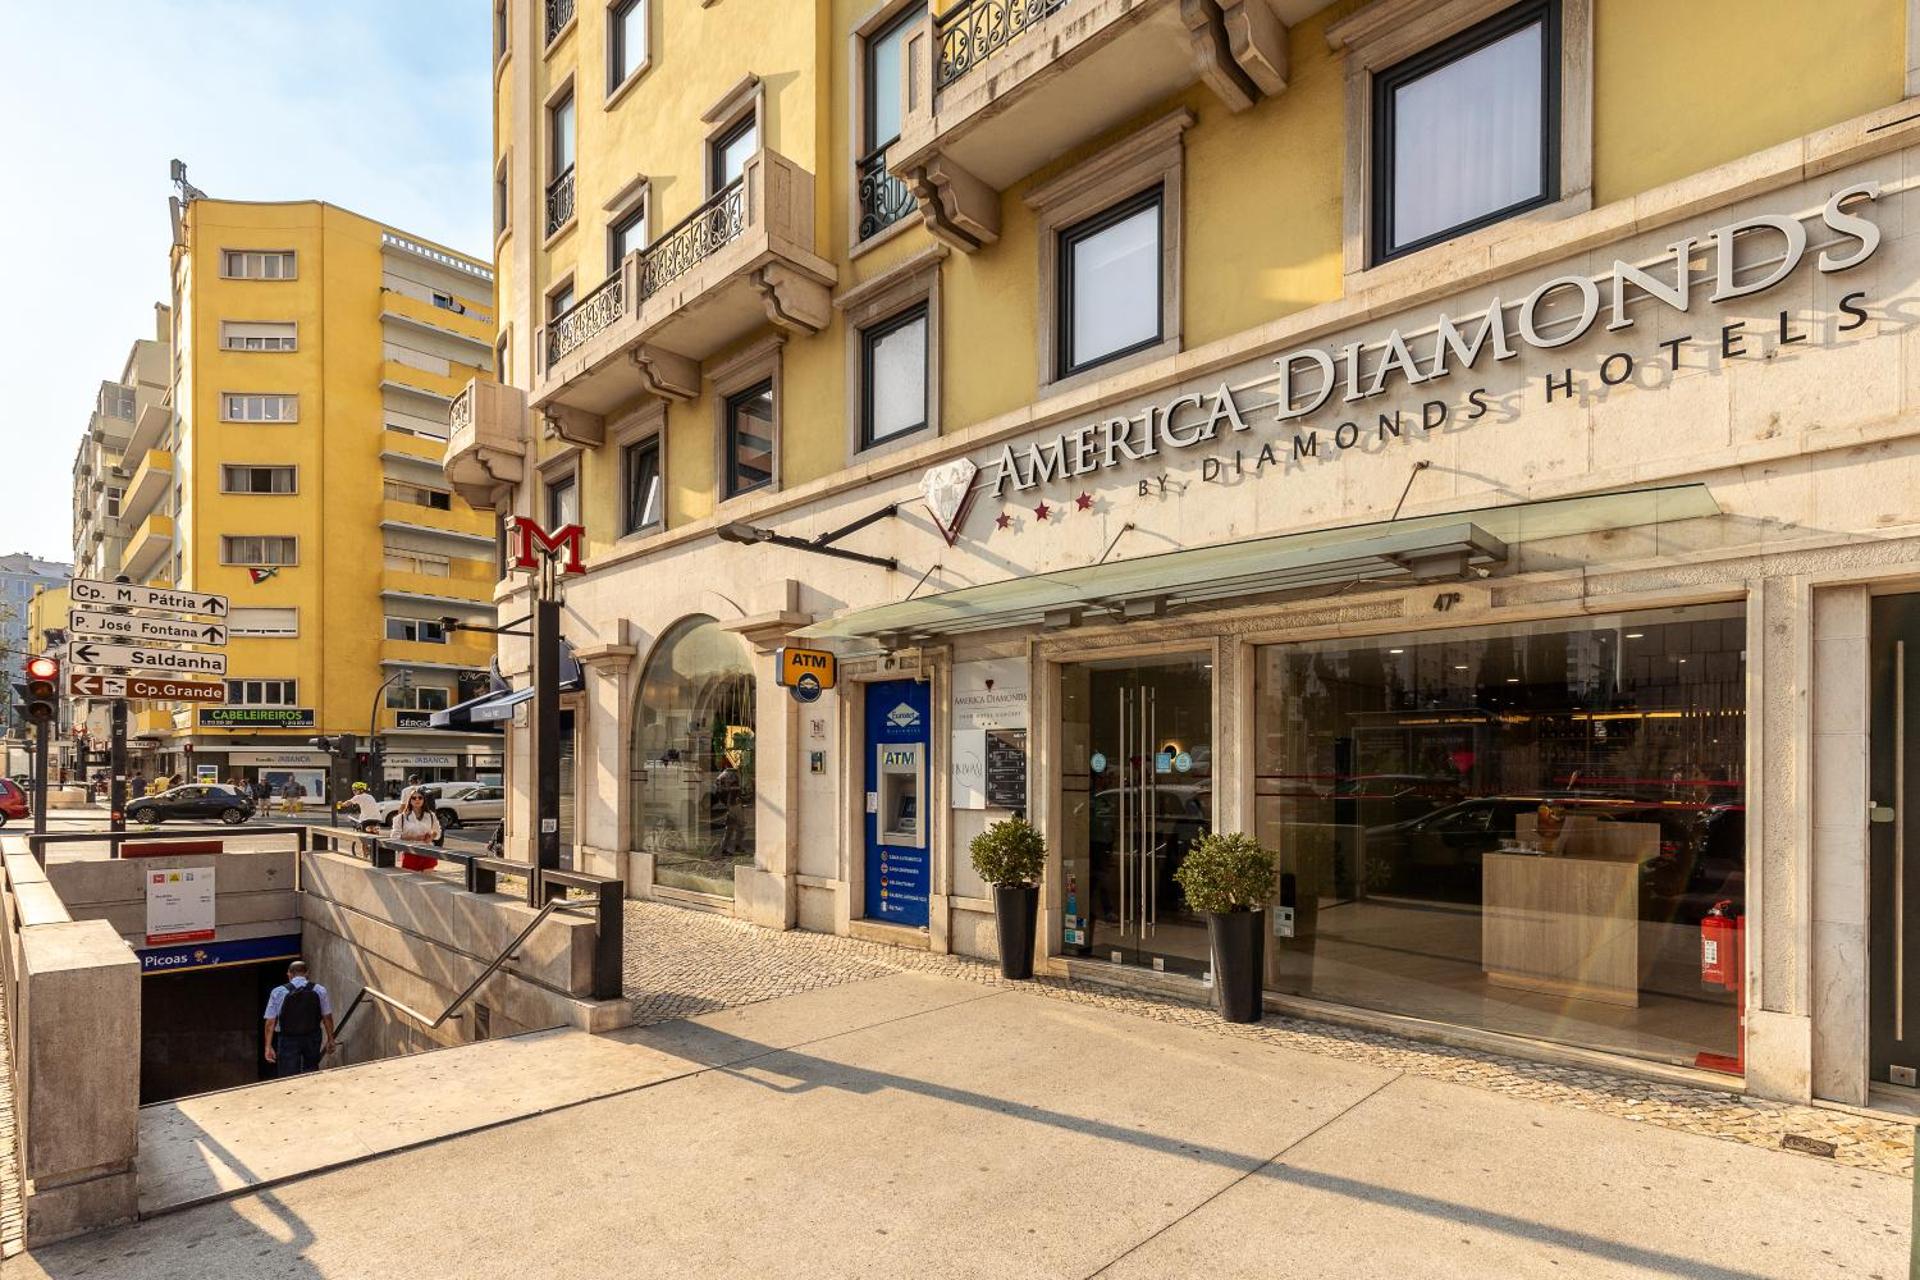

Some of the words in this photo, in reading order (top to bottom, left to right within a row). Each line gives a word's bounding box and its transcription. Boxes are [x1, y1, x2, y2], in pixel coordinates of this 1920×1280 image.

[989, 383, 1249, 498] AMERICA
[1273, 181, 1883, 421] DIAMONDS
[1139, 474, 1168, 497] BY
[1203, 388, 1487, 481] DIAMONDS
[1545, 291, 1868, 402] HOTELS
[76, 585, 105, 599] Cp.
[117, 589, 136, 602] M.
[149, 592, 196, 609] Pátria
[76, 617, 89, 628] P.
[99, 618, 131, 632] José
[141, 623, 198, 638] Fontana
[131, 651, 222, 671] Saldanha
[792, 653, 826, 668] ATM
[212, 710, 302, 720] CABELEIREIROS
[885, 751, 915, 765] ATM
[145, 953, 188, 967] Picoas
